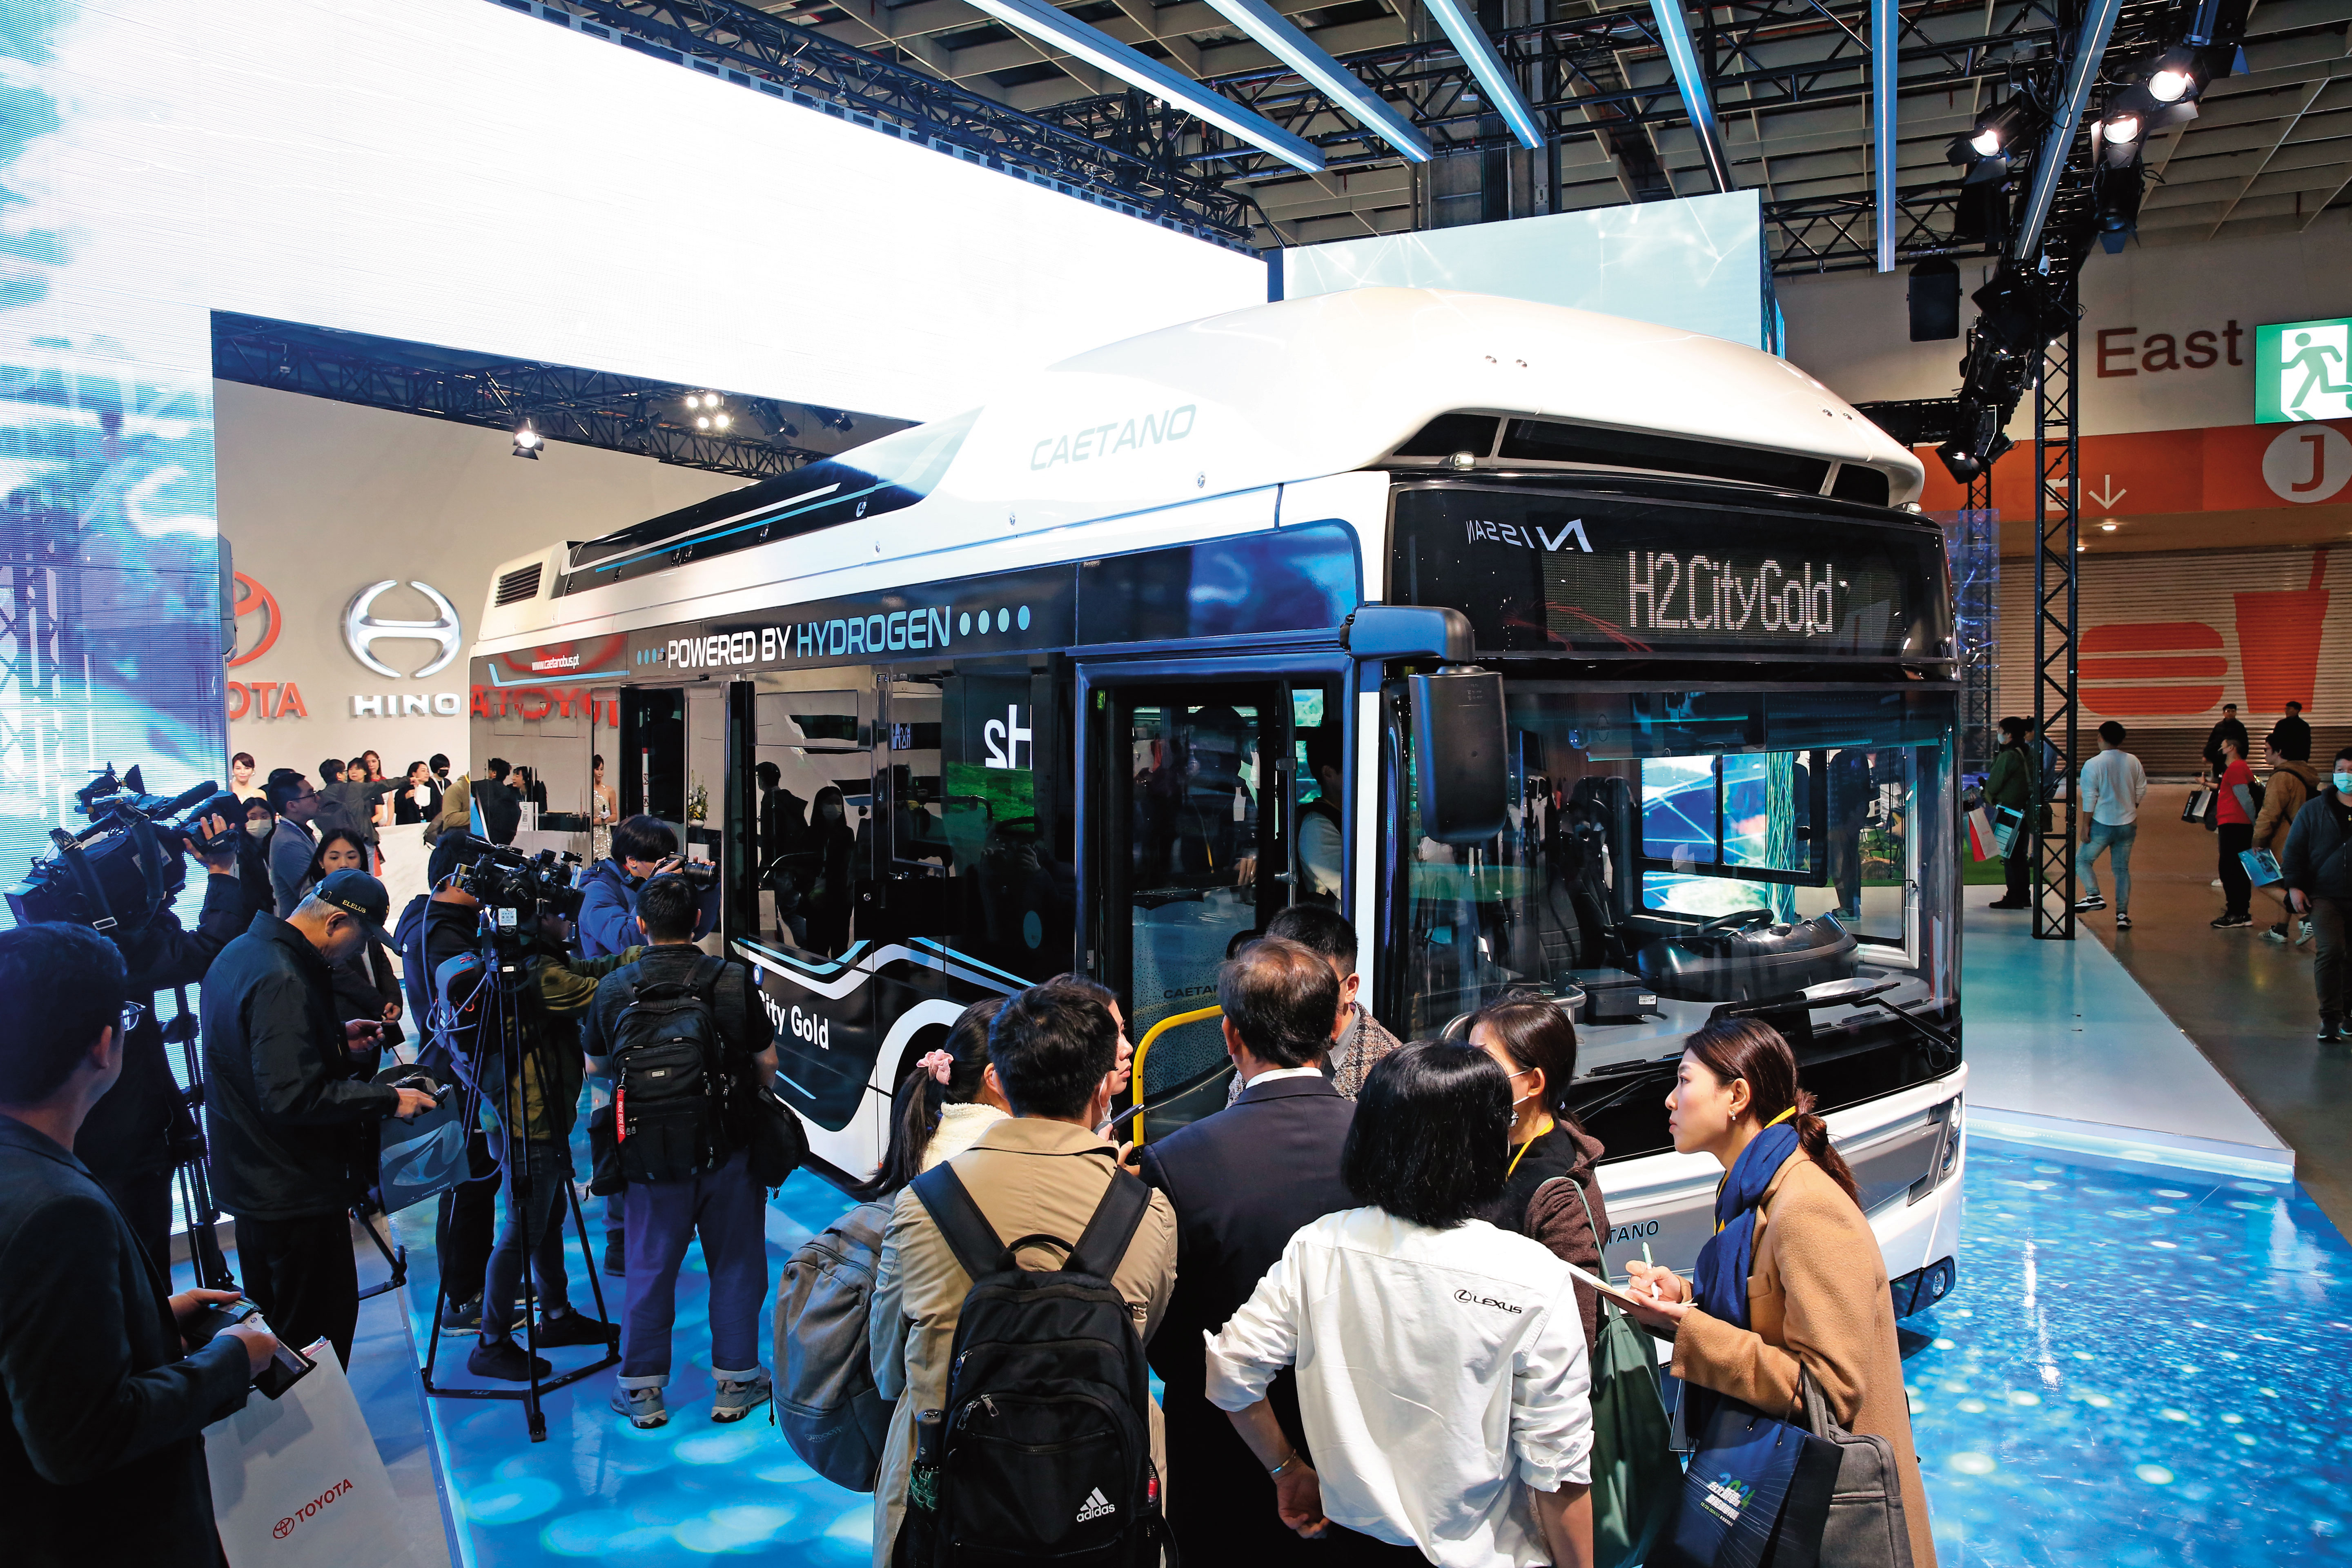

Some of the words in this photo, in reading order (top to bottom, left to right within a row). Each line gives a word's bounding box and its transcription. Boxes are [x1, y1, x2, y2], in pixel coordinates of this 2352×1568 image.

[2097, 320, 2243, 379] East
[1030, 404, 1197, 471] CAETANO
[2291, 434, 2326, 492] J
[668, 630, 756, 669] POWERED
[761, 625, 792, 662] BY
[797, 605, 951, 658] HYDROGEN
[532, 653, 579, 671] www.caetanobus.pt
[228, 681, 308, 719] OTA
[352, 693, 461, 717] HINO
[342, 900, 366, 913] ELELUB
[1163, 984, 1218, 999] CAETA
[791, 1005, 829, 1050] Gold
[1608, 1220, 1659, 1245] TANO
[1473, 1295, 1522, 1314] LEXUS
[295, 1479, 353, 1523] TOYOTA
[1076, 1504, 1116, 1522] adidas
